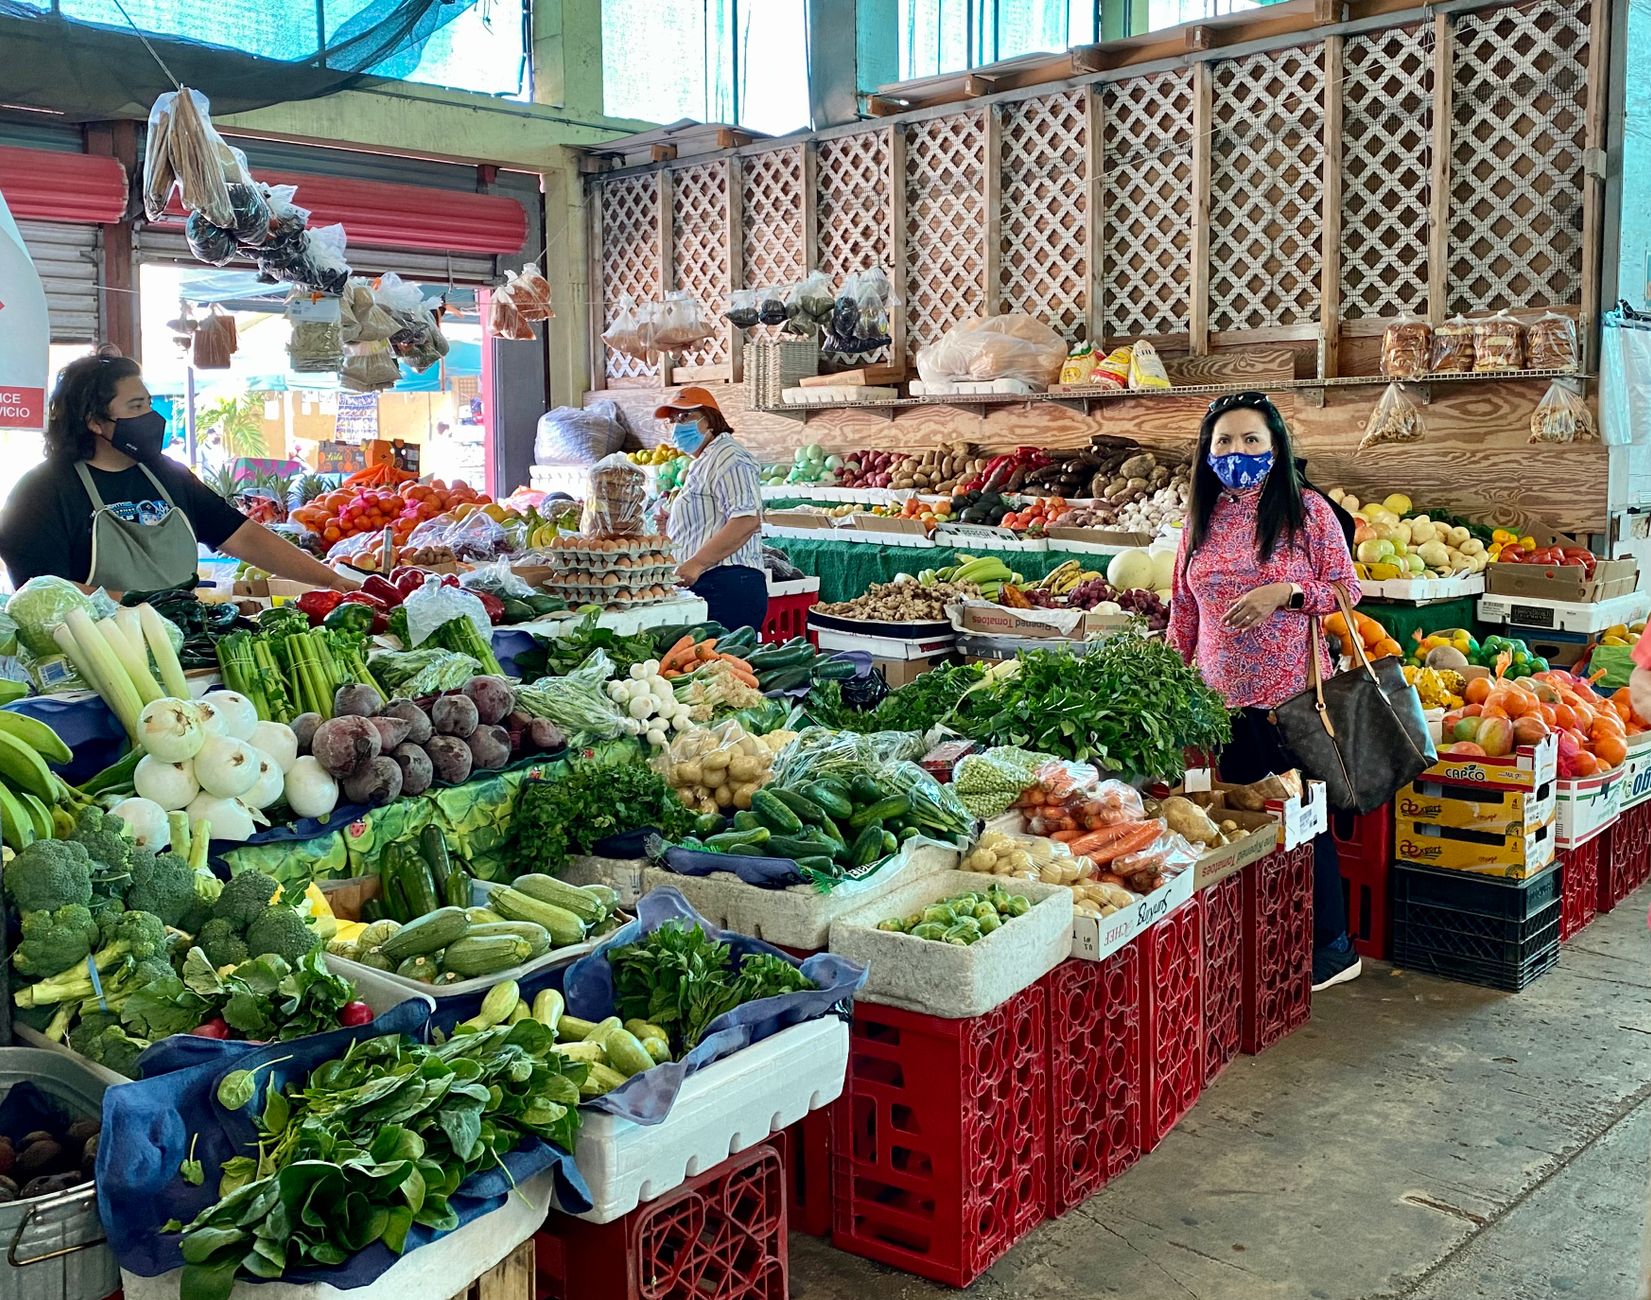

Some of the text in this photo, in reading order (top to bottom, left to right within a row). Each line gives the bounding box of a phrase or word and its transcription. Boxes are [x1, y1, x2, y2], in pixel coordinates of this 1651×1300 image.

[972, 615, 1013, 628] Tomatoes
[1445, 768, 1486, 782] CAPCO
[1201, 854, 1236, 878] Tomatoes
